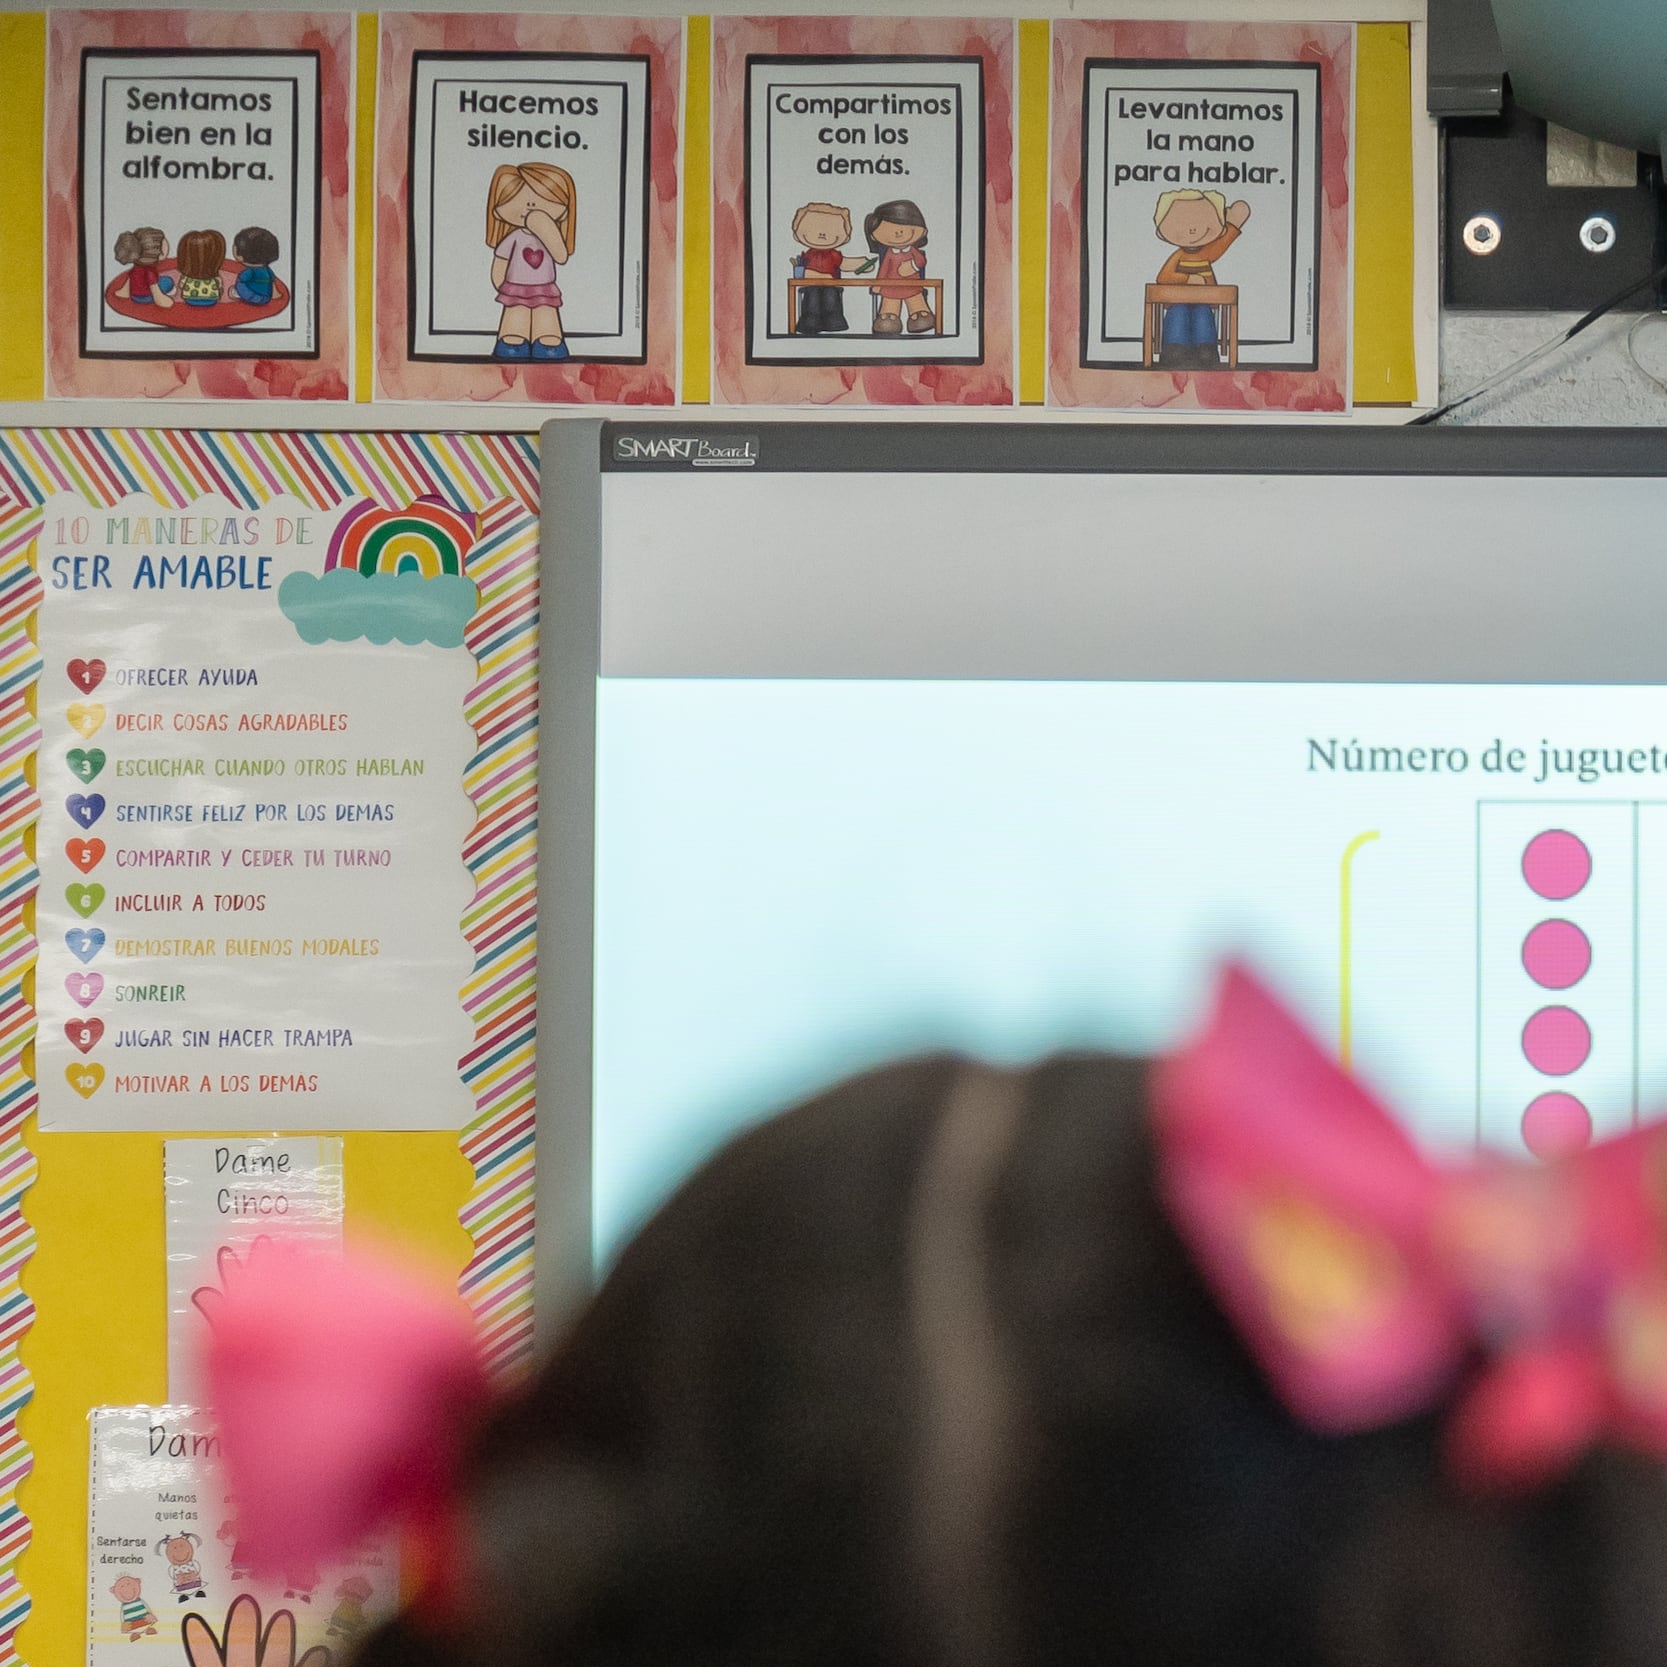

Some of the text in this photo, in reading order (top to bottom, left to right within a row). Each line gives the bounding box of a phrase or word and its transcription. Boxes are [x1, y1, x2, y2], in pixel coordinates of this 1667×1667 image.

[127, 86, 271, 111] Sentamos
[460, 90, 598, 116] Hacemos
[776, 94, 951, 119] Compartimos
[1119, 98, 1283, 121] Levantamos
[126, 120, 272, 146] bien en la
[468, 124, 588, 150] silencio.
[818, 124, 908, 144] con los
[1147, 129, 1254, 152] la mano
[123, 155, 273, 180] alfombra.
[817, 154, 909, 175] demás.
[1114, 161, 1285, 187] para hablar.
[618, 437, 698, 457] SMART
[55, 516, 313, 545] 10 MANERAS DE
[53, 555, 272, 590] SER AMABLE
[81, 668, 257, 686] 1 OFRECER AYUDA
[116, 713, 163, 731] DECIR
[174, 714, 228, 731] COSAS
[238, 714, 348, 731] AGRADABLES
[1308, 739, 1468, 772] Número
[1481, 739, 1526, 773] de
[81, 758, 424, 777] 3 ESCUCHAR CUANDO OTROS HABLAN
[80, 807, 91, 820] 4
[117, 805, 192, 822] SENTIRSE
[203, 805, 246, 822] FELIZ
[256, 804, 287, 821] POR
[298, 804, 326, 821] LOS
[81, 849, 391, 867] 5 COMPARTIR Y CEDER TU TURNO
[81, 895, 265, 912] 6 INCLUIR A TODOS
[81, 938, 379, 957] 7 DEMOSTRAR BUENOS MODALES
[80, 984, 185, 1002] 8 SONREIR
[80, 1029, 352, 1048] 9 JUGAR SIN HACER TRAMPA
[77, 1076, 94, 1088] 10
[116, 1074, 190, 1093] MOTIVAR
[200, 1075, 211, 1092] A
[221, 1075, 249, 1092] LOS
[216, 1145, 292, 1176] Dame
[217, 1188, 288, 1216] Cinco
[149, 1425, 221, 1458] Dam
[158, 1493, 197, 1503] Manos
[155, 1510, 198, 1521] quietas
[97, 1536, 146, 1547] Sentarse
[100, 1554, 144, 1564] derecho
